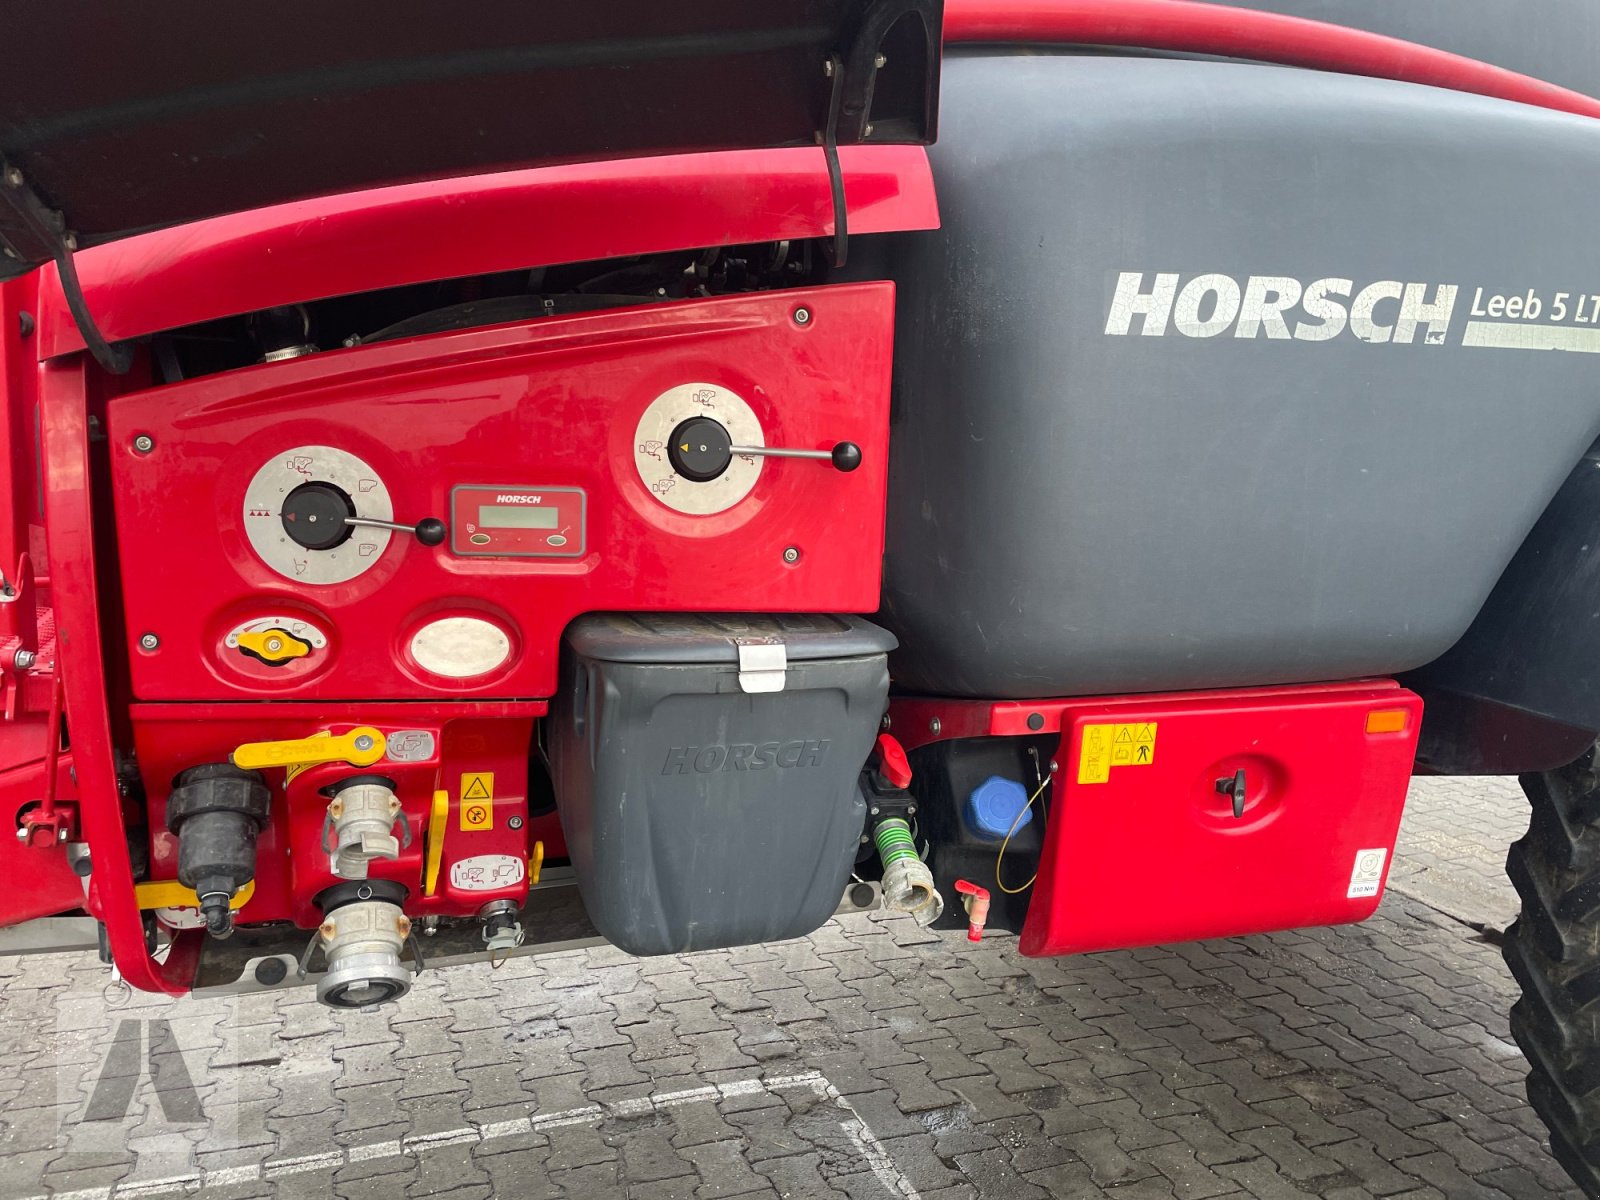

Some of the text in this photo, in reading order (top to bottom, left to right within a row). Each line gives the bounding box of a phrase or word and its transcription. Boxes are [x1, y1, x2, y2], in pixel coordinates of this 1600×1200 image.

[1104, 271, 1459, 345] HORSCH
[1470, 287, 1542, 320] Leeb
[1550, 292, 1570, 322] 5
[496, 494, 541, 504] HORSCH
[661, 739, 832, 776] HORSCH
